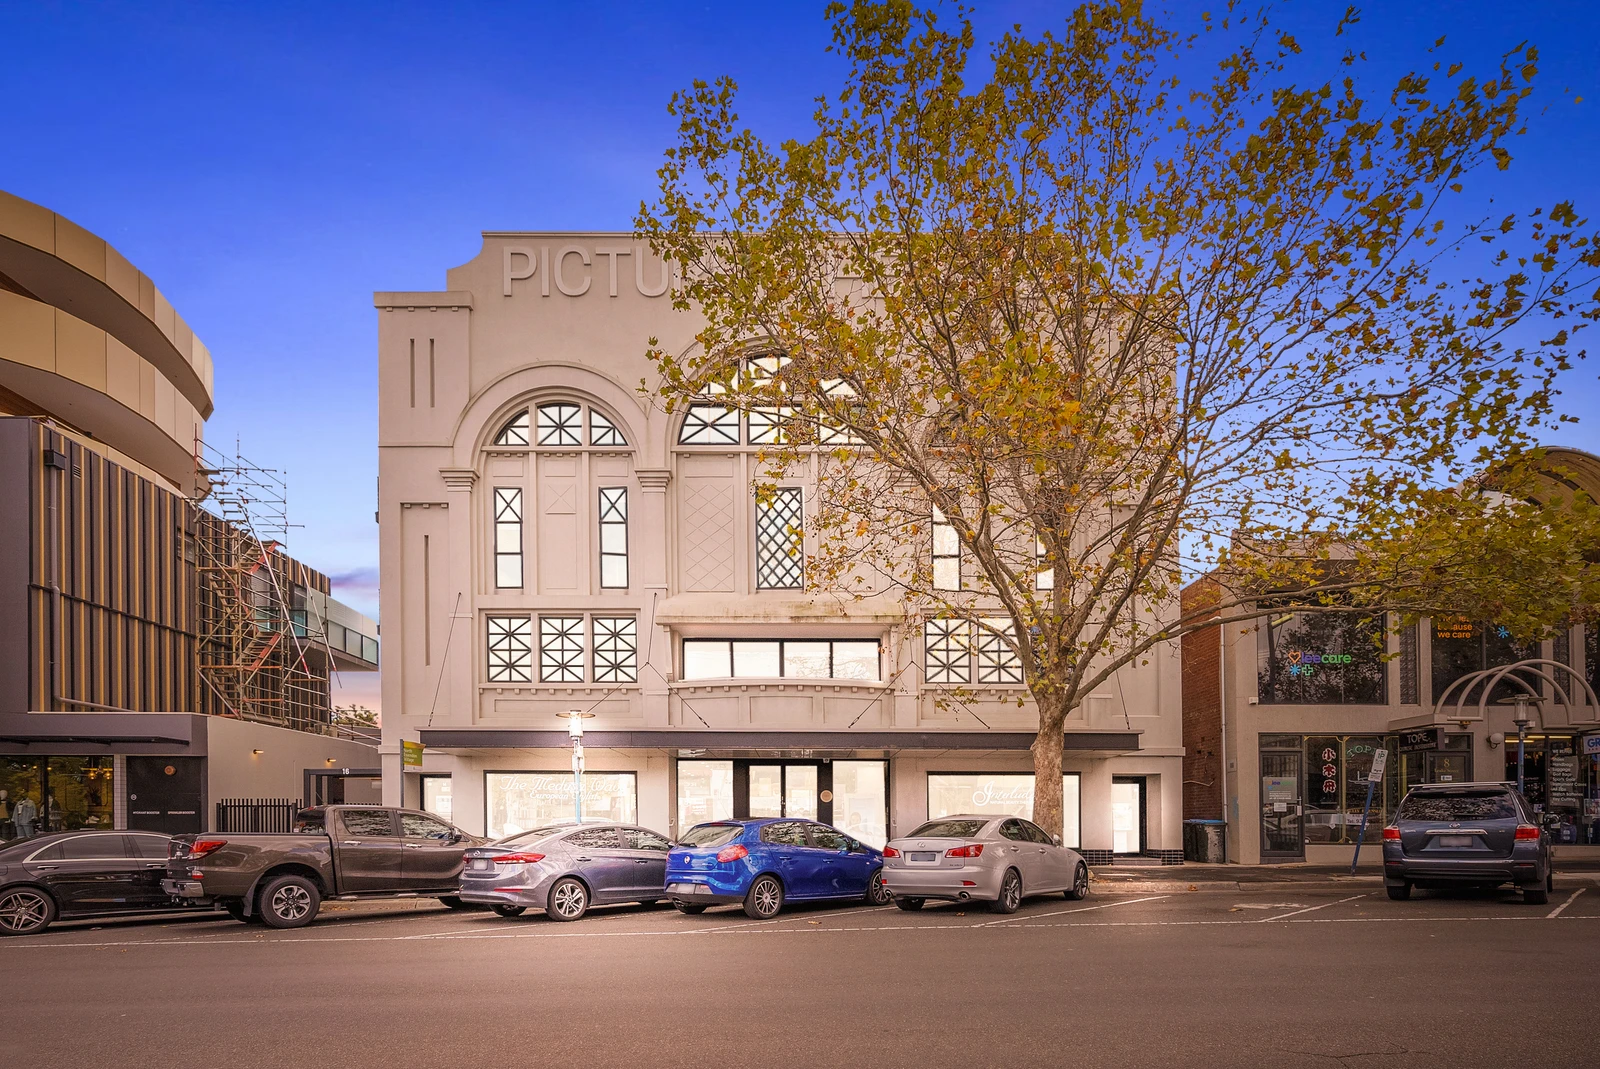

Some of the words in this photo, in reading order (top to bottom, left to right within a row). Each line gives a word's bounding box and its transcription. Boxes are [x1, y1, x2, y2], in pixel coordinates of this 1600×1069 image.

[503, 244, 712, 298] PICTU
[1438, 622, 1473, 631] bause
[1301, 651, 1352, 664] leecare
[1444, 758, 1450, 767] 8
[500, 776, 527, 790] The
[530, 790, 568, 800] European
